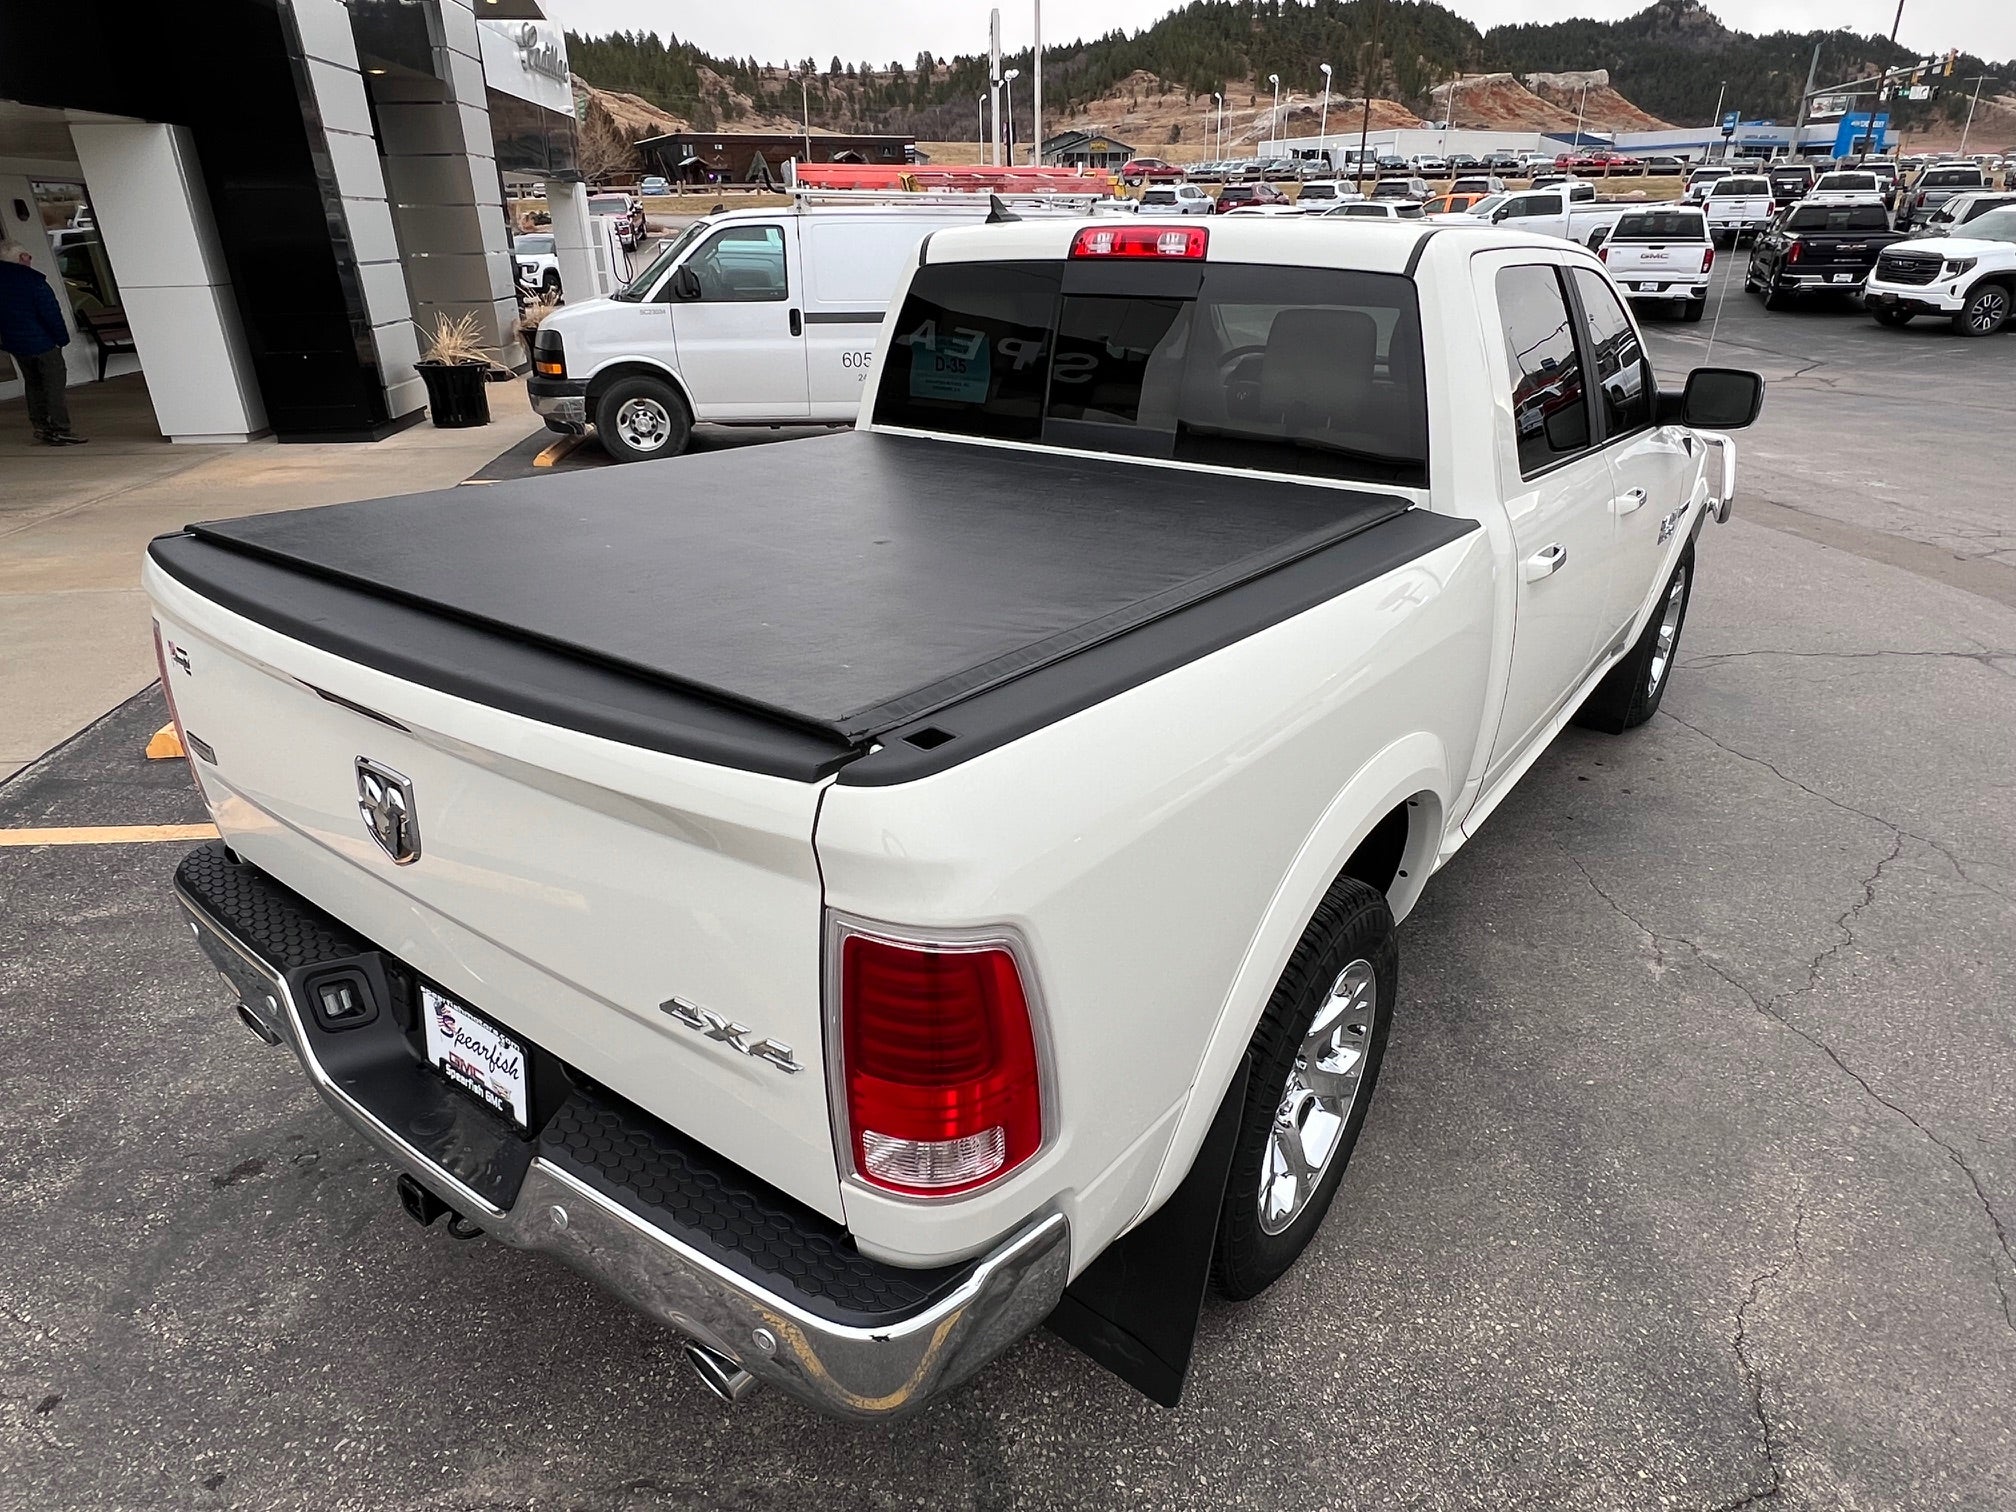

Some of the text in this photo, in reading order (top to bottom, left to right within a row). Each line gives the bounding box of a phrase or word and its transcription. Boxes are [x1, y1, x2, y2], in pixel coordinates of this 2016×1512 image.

[842, 352, 872, 368] 605
[935, 356, 967, 374] D-35
[440, 1014, 520, 1081] Spearfish
[449, 1051, 485, 1086] GMC
[445, 1063, 504, 1111] Spearfish GMC
